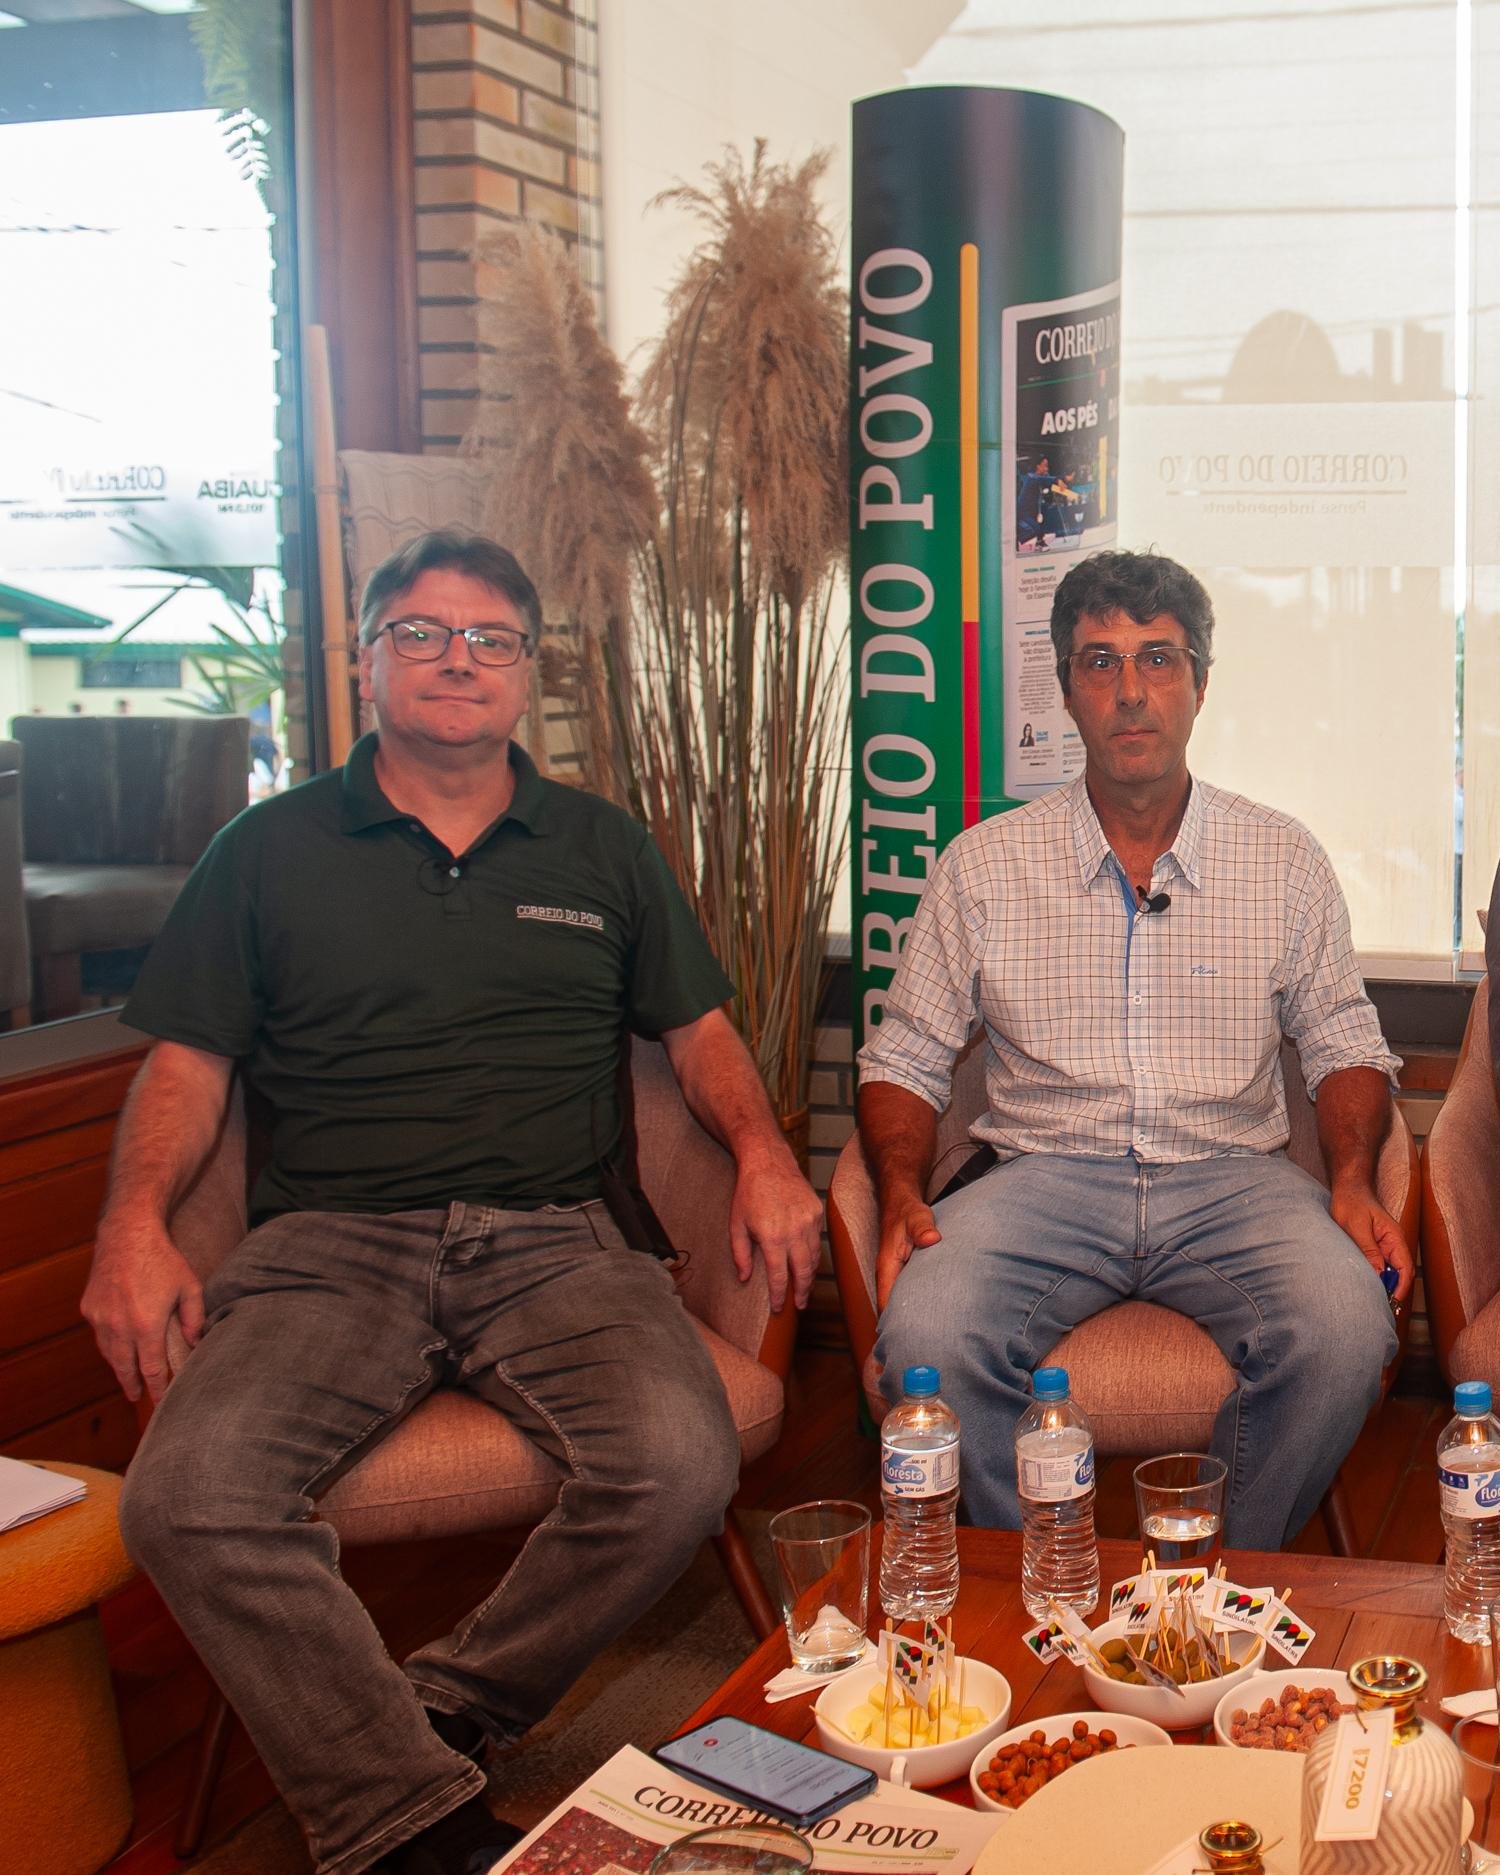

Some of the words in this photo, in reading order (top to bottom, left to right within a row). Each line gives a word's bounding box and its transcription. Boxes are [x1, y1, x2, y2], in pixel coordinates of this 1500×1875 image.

[858, 247, 934, 531] POVO
[1041, 407, 1076, 436] AOS
[1077, 400, 1099, 430] PÉS
[859, 562, 936, 702] DO
[516, 905, 564, 919] CORREIO
[565, 910, 579, 922] DO
[580, 912, 604, 927] POVO
[884, 1462, 924, 1481] floresta
[842, 1821, 939, 1850] POVO
